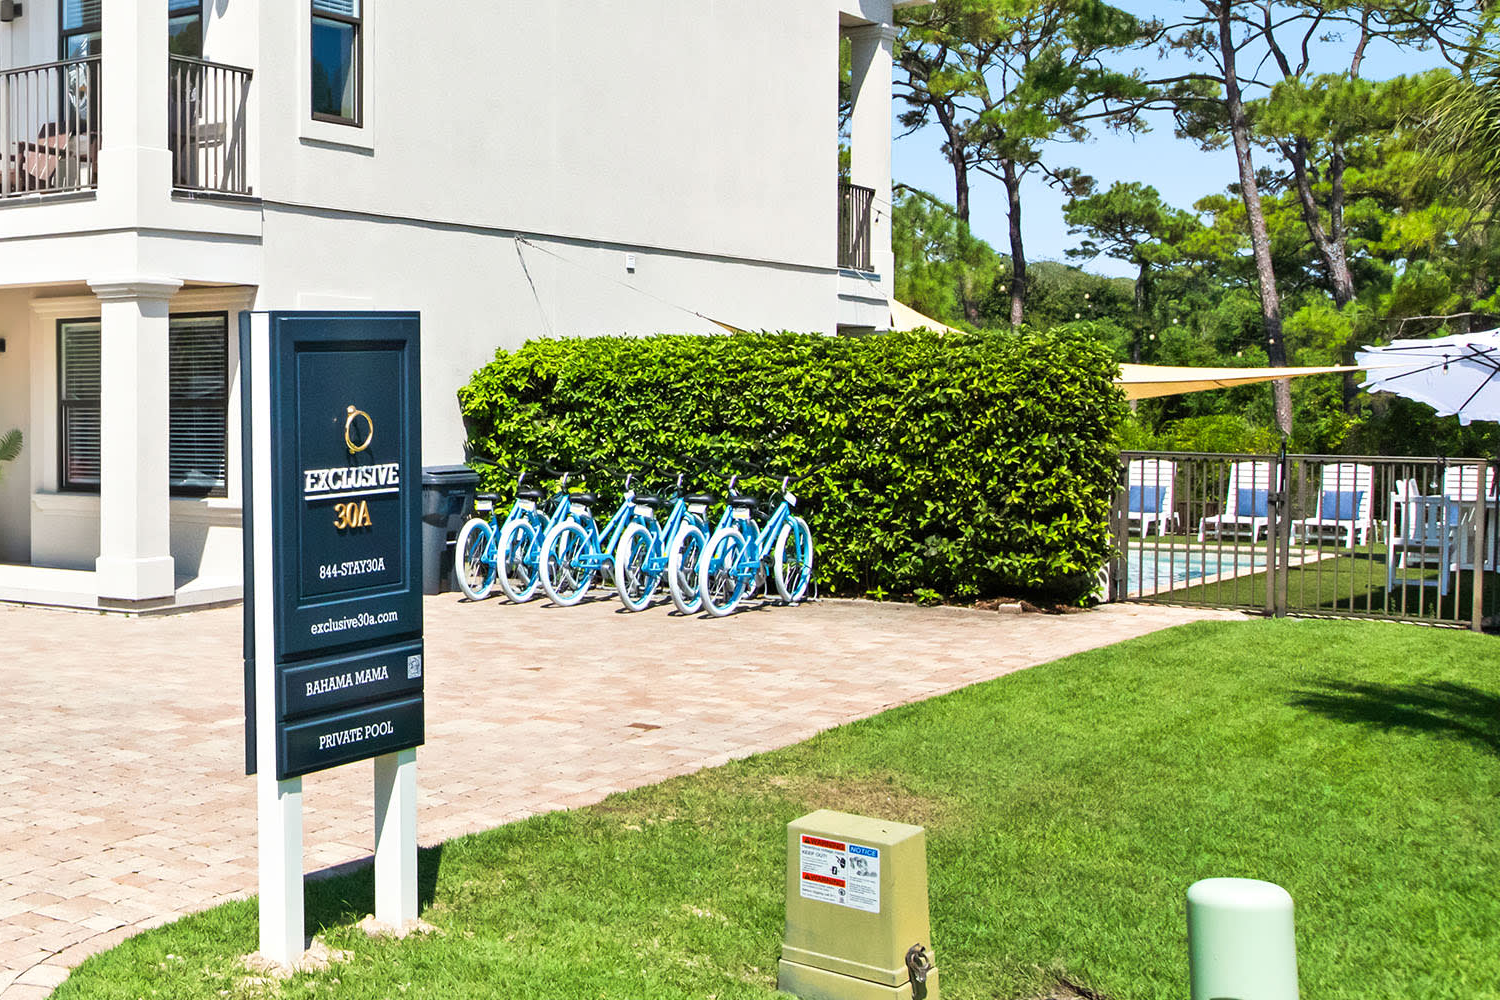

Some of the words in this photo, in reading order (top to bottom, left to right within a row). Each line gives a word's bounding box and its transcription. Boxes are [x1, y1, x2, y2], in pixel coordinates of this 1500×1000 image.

[304, 463, 399, 492] EXCLUSIVE
[333, 500, 373, 529] 30A
[319, 557, 386, 580] 844-STAY30A
[311, 611, 398, 635] exclusive30a.com
[306, 674, 354, 697] BAHAMA
[354, 665, 389, 686] MAMA
[318, 728, 364, 750] PRIVATE
[364, 720, 394, 740] POOL
[850, 846, 877, 857] NOTICE
